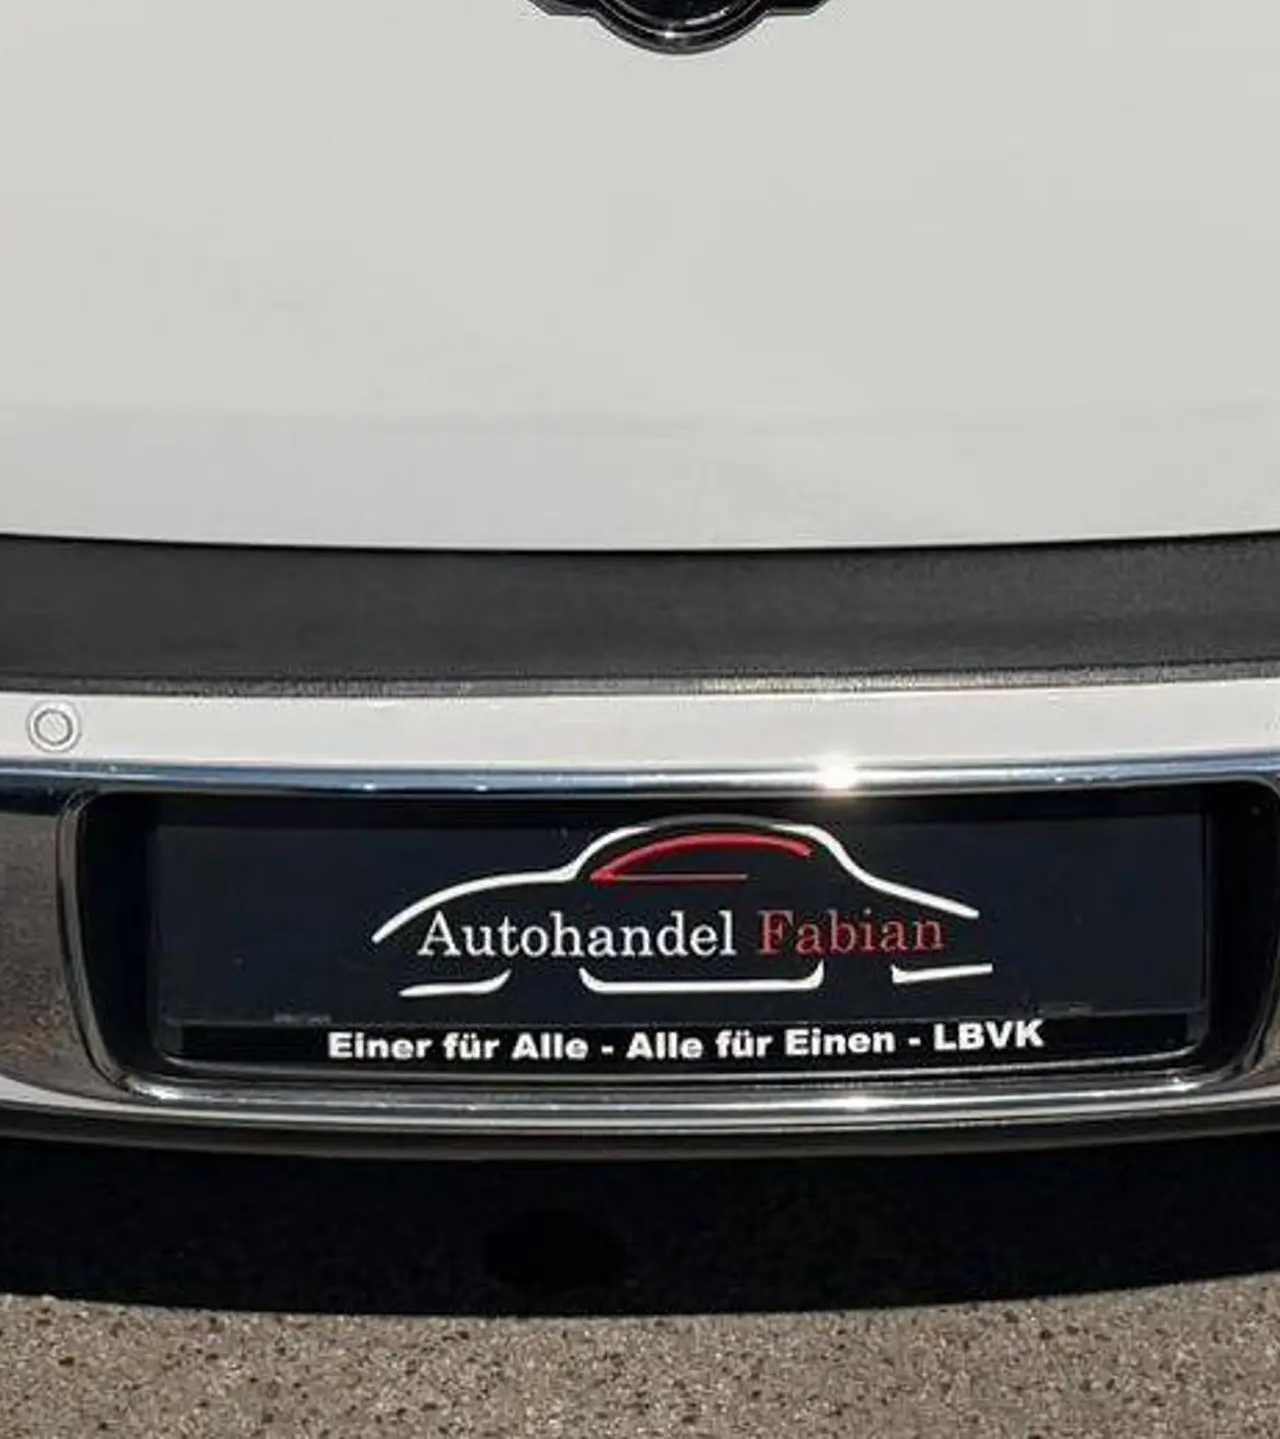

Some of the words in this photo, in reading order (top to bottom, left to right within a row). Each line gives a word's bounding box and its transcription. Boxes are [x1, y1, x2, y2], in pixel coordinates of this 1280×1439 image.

[417, 910, 737, 958] Autohandel
[757, 906, 947, 955] Fabian
[327, 1031, 432, 1060] Einer
[442, 1030, 499, 1060] für
[511, 1031, 589, 1060] Alle
[626, 1031, 704, 1060] Alle
[716, 1028, 773, 1059] für
[785, 1024, 895, 1057] Einen
[933, 1018, 1046, 1052] LBVK
